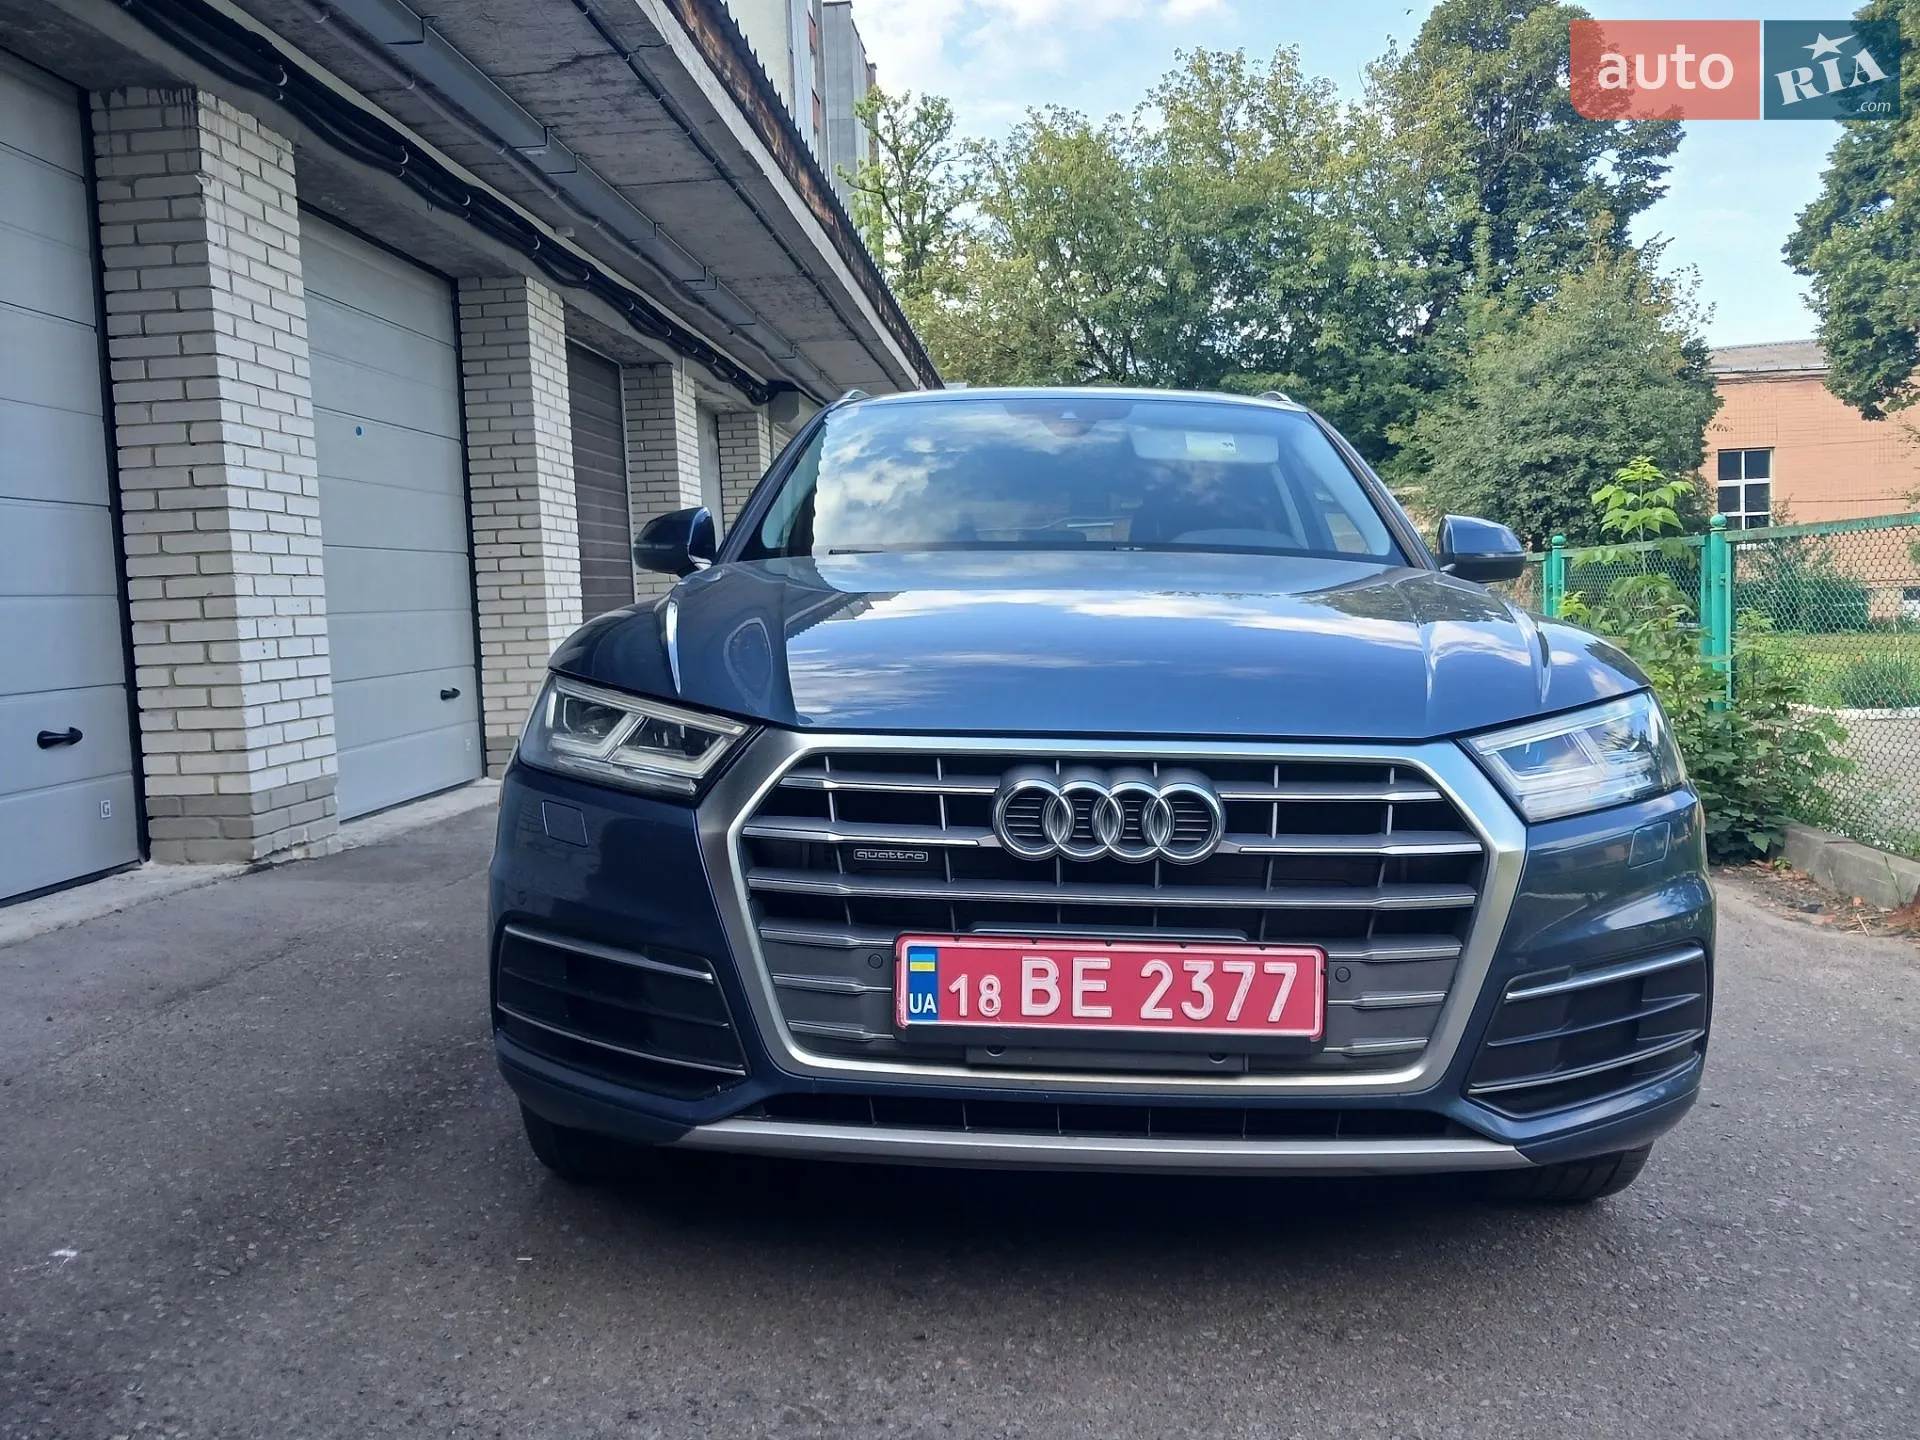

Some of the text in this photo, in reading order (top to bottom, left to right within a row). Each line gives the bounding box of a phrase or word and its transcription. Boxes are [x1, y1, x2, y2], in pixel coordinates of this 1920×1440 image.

[857, 851, 925, 860] quattro
[949, 956, 1297, 1022] 18 BE 2377
[909, 993, 937, 1014] UA
